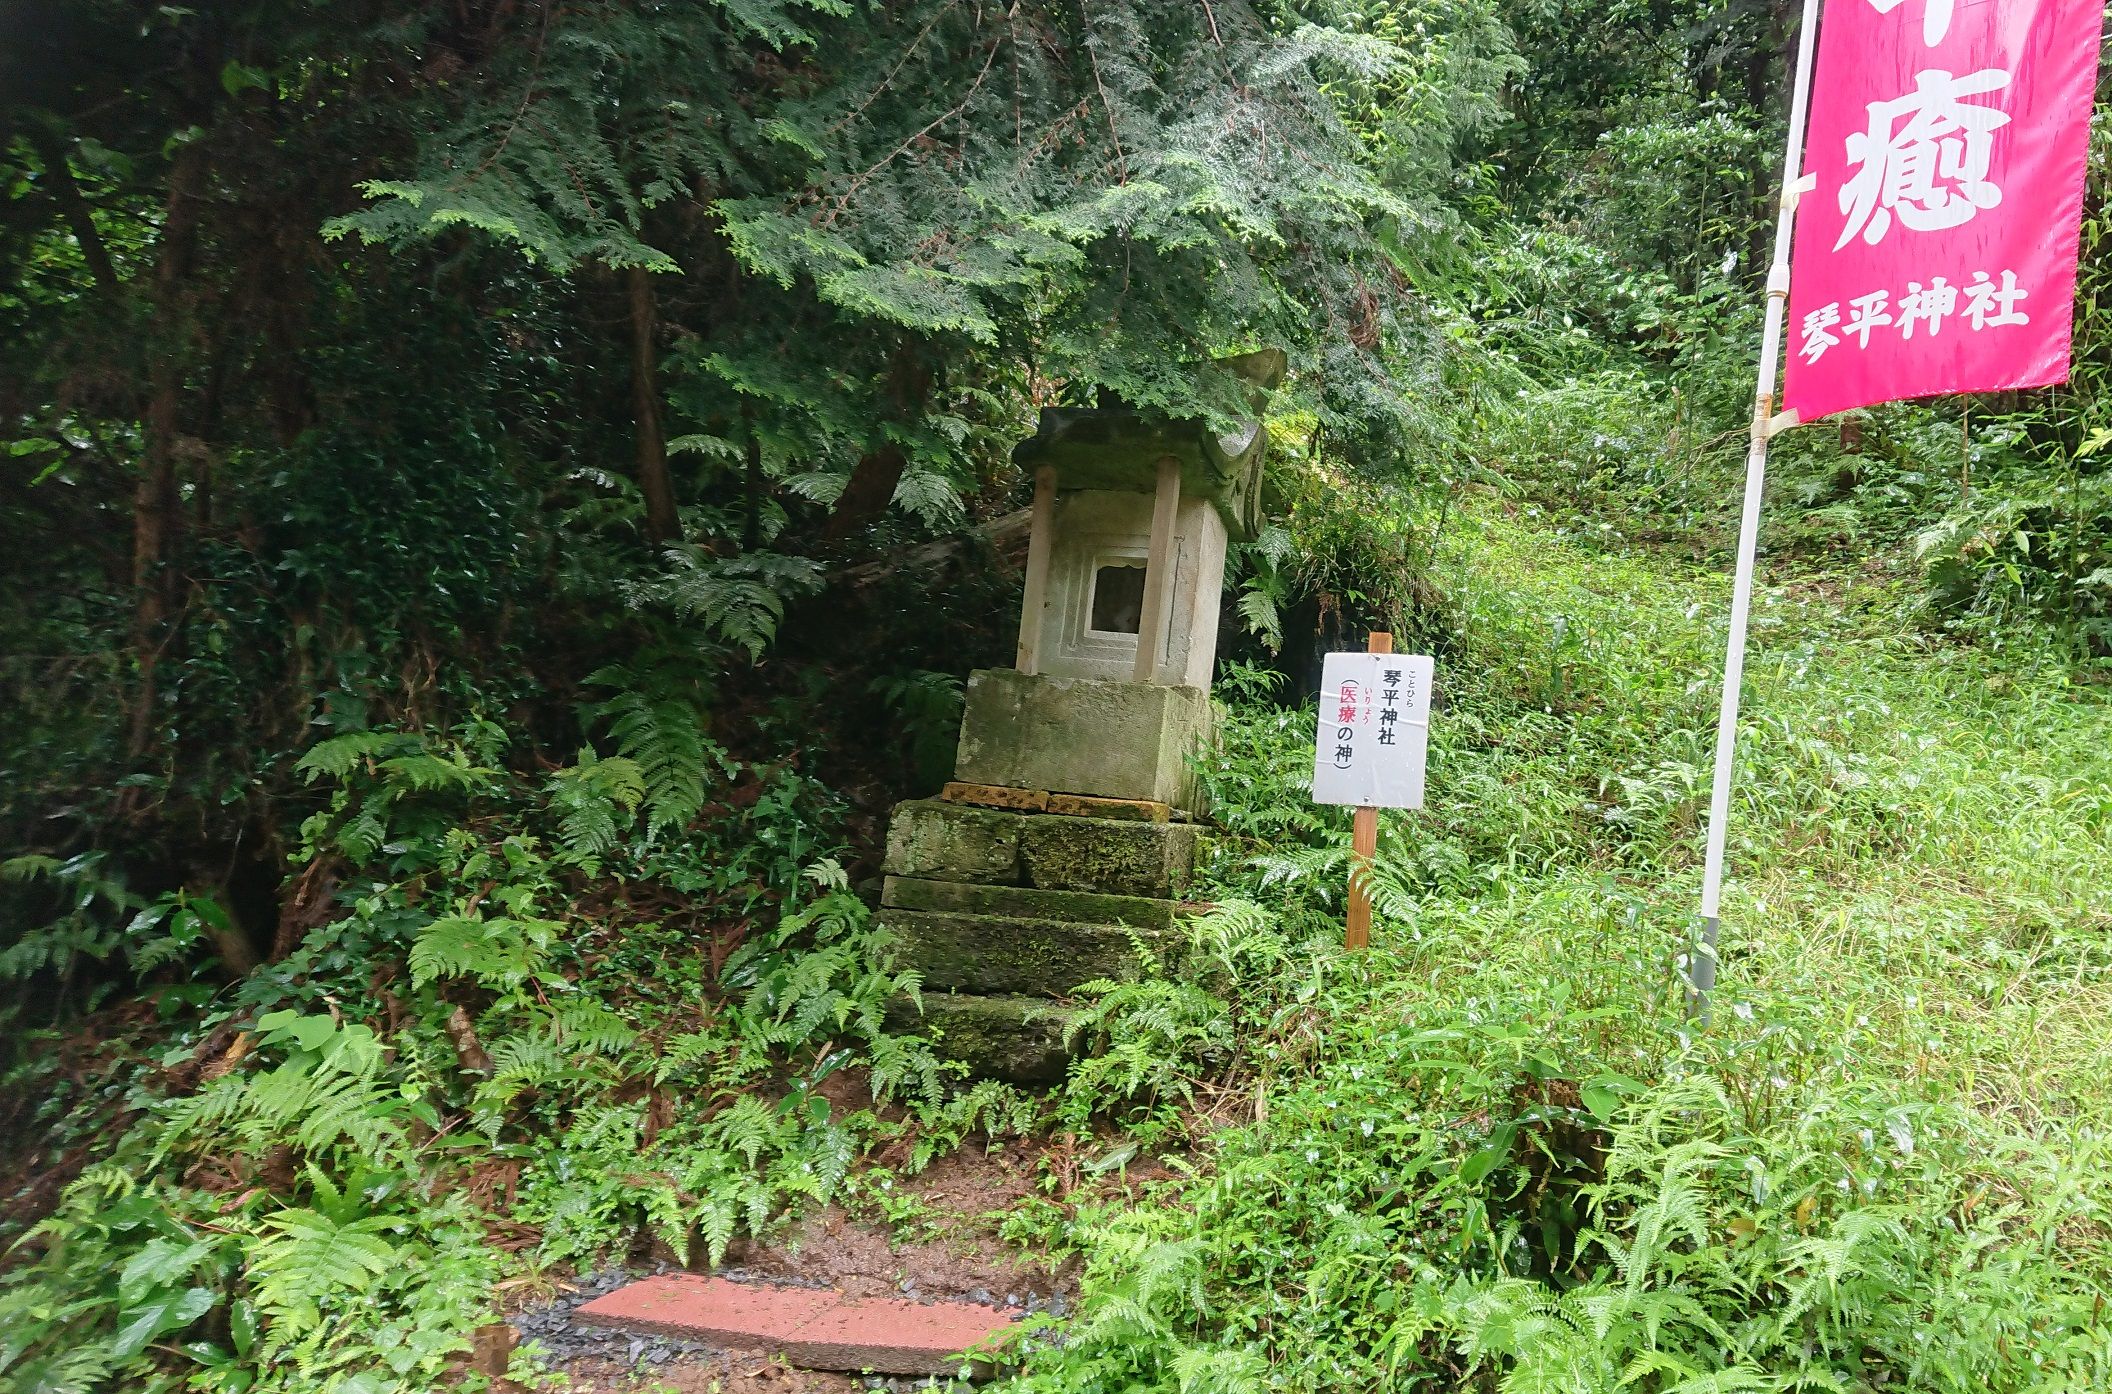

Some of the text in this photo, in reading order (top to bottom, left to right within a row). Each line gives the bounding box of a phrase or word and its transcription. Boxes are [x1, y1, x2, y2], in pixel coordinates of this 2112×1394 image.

[1798, 269, 2030, 365] 琴平神社
[1333, 679, 1360, 770] （医療の神）
[1363, 687, 1373, 725] いりょう
[1378, 669, 1402, 746] 琴平神社
[1406, 670, 1417, 708] ことひら
